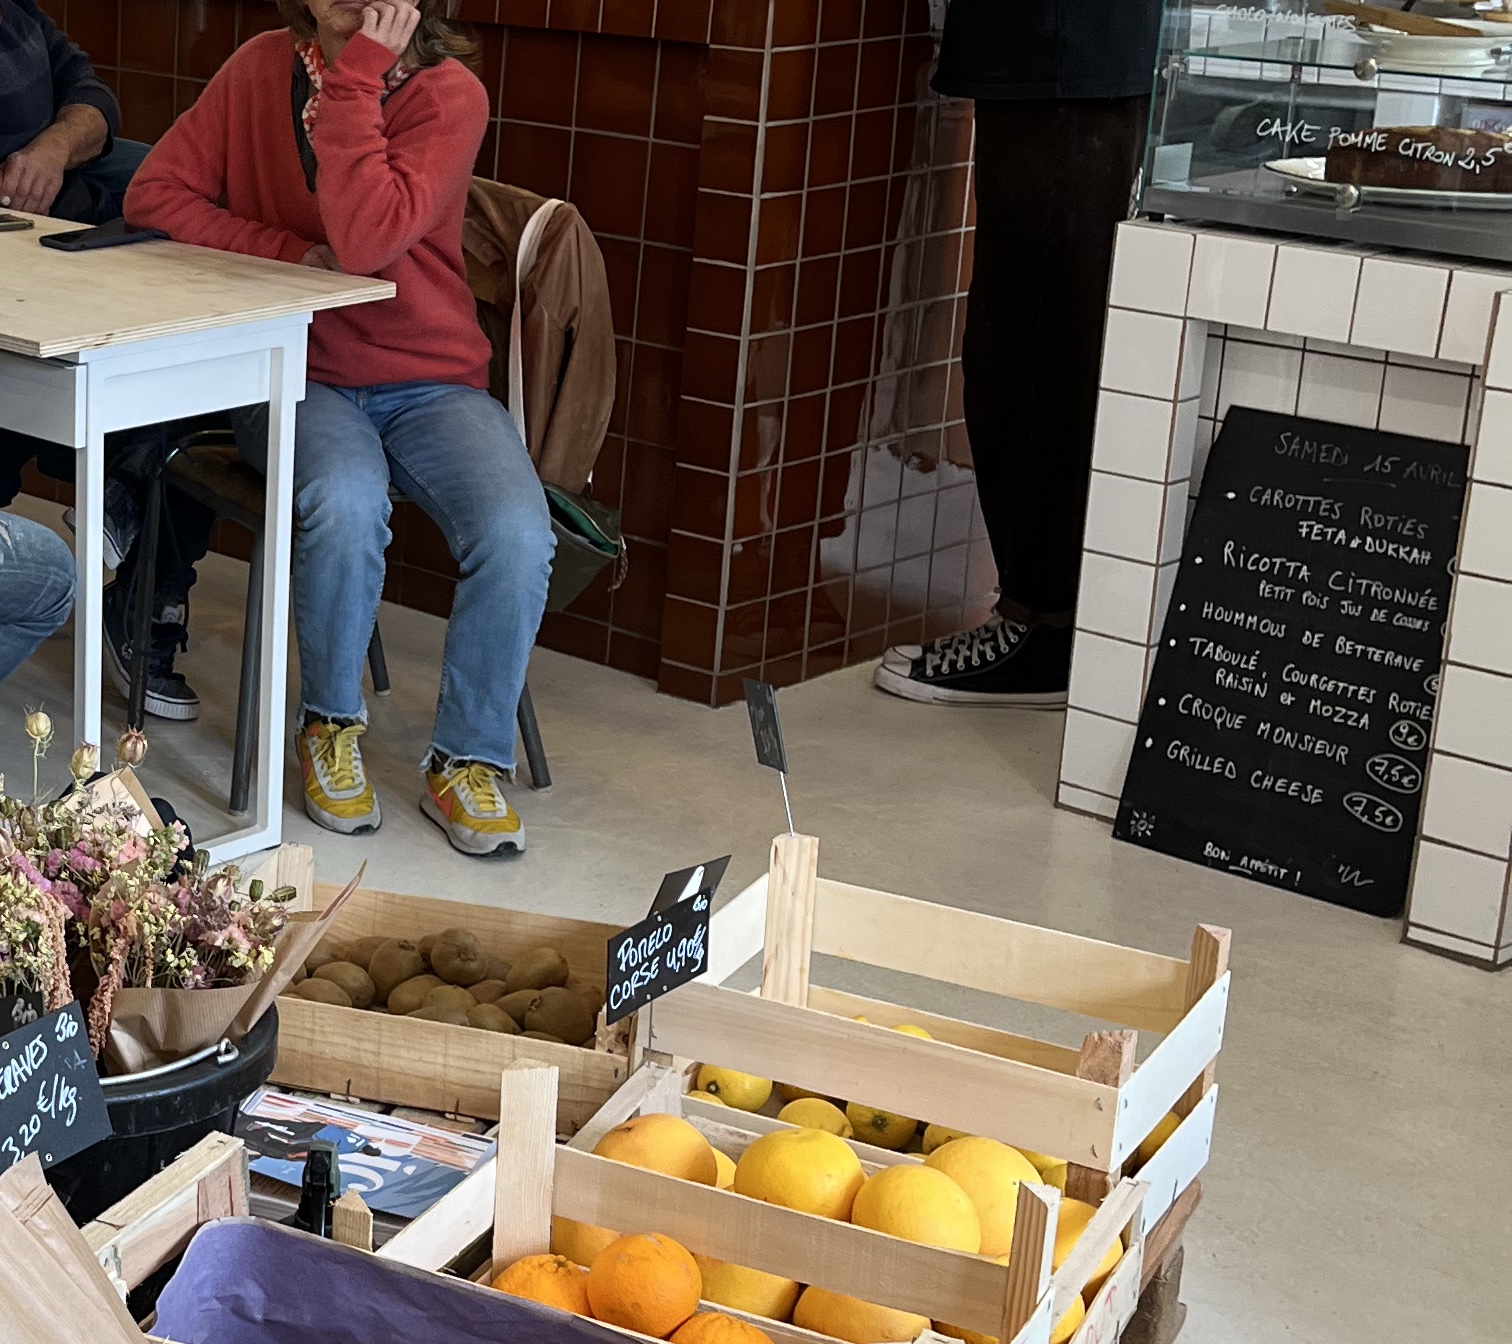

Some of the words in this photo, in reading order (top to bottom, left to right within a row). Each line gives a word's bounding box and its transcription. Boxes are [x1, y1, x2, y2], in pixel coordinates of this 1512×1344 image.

[1256, 117, 1322, 145] CAKE
[1327, 126, 1389, 153] POMME
[1363, 455, 1401, 474] 15
[1248, 485, 1345, 520] CAROTTES
[1298, 520, 1347, 545] FETA
[1364, 536, 1433, 567] DUKKAH
[1370, 608, 1388, 624] DE
[1202, 601, 1287, 639] HOUMMOUS
[1302, 631, 1325, 649] DE
[1335, 636, 1425, 673] BETTERAVE
[1282, 663, 1377, 704] COURGETTES
[1178, 693, 1247, 730] CROQUE
[1309, 699, 1370, 731] MOZZA
[1251, 770, 1324, 805] CHEESE
[1203, 841, 1231, 862] BON
[617, 923, 673, 972] POMELO
[610, 956, 660, 1010] CORSE
